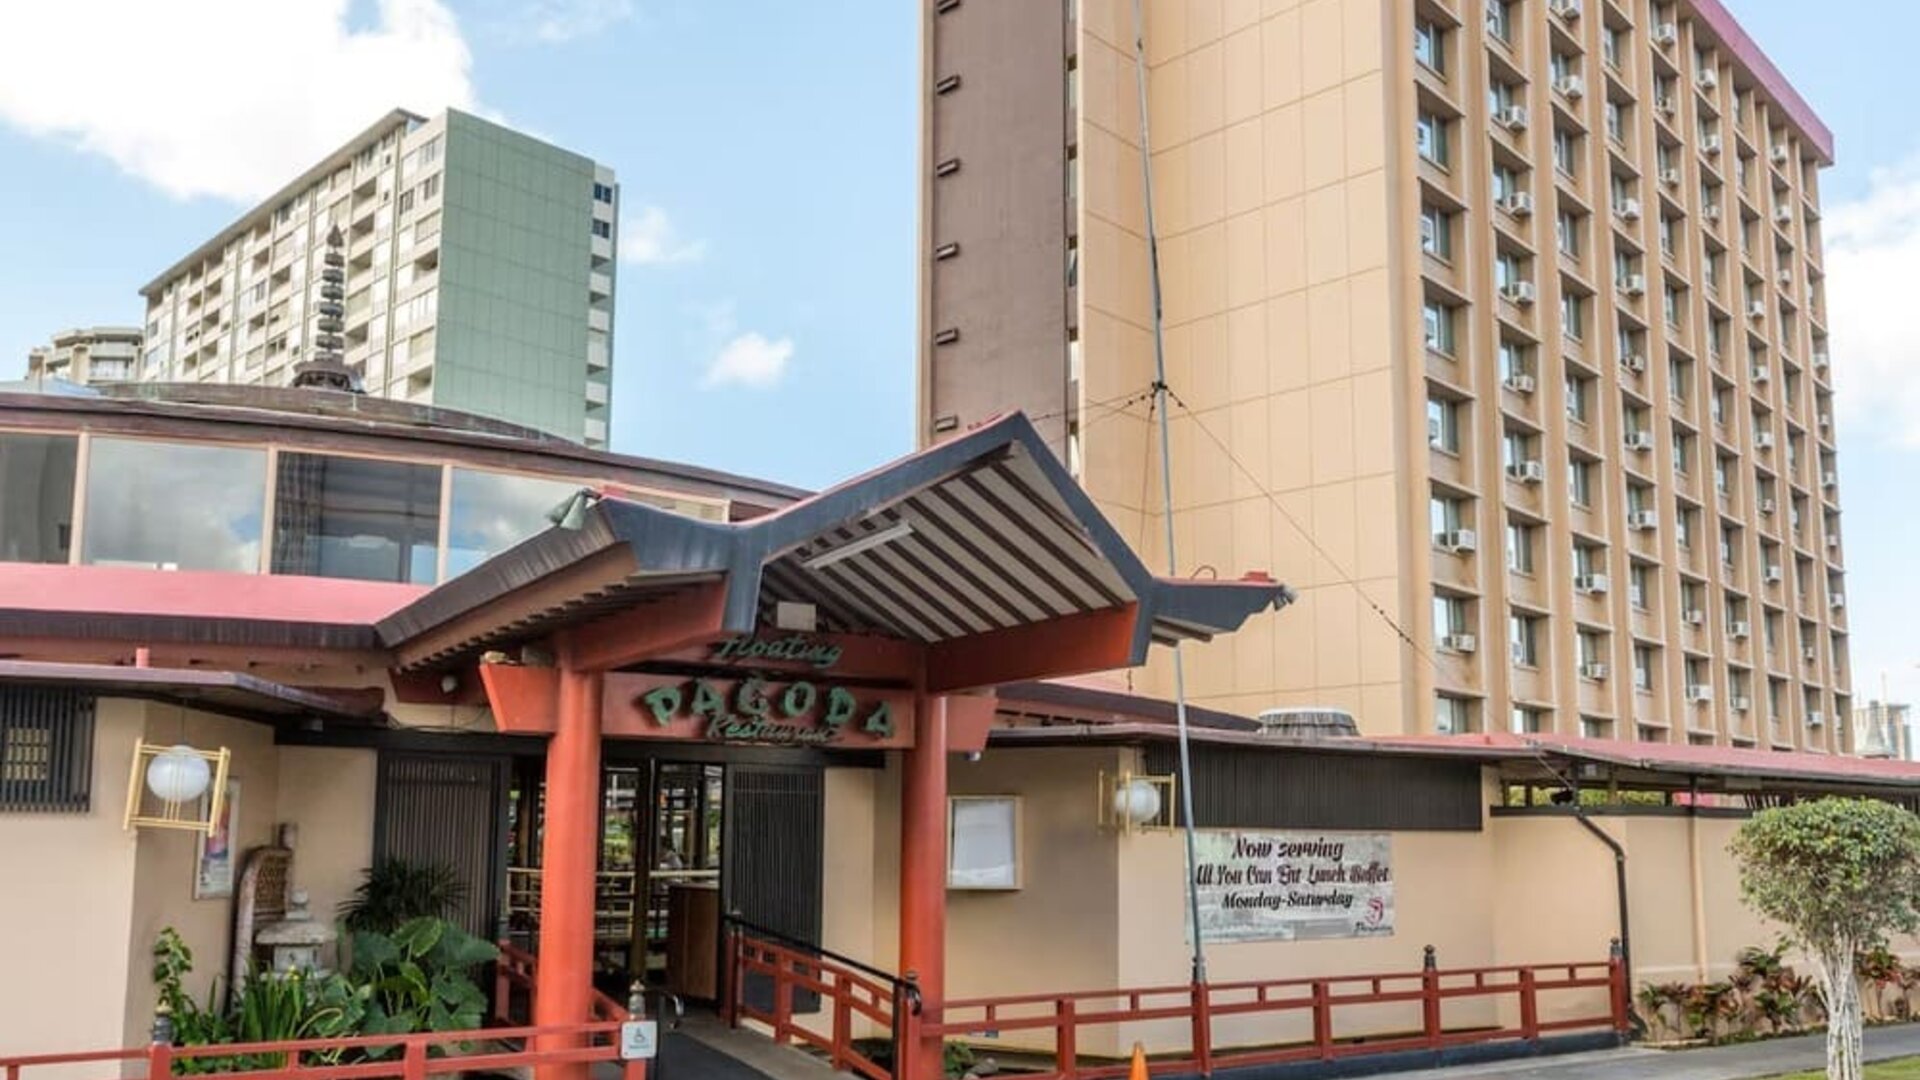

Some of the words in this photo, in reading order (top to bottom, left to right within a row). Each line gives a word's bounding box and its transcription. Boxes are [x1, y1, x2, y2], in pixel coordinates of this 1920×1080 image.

[645, 674, 895, 738] PAGODA
[1232, 837, 1272, 859] Now
[1277, 837, 1344, 862] serving
[1217, 864, 1242, 886] You
[1247, 864, 1273, 886] Can
[1277, 864, 1301, 886] Eat
[1307, 863, 1345, 885] Lunch
[1221, 889, 1354, 911] Monday-Saturday
